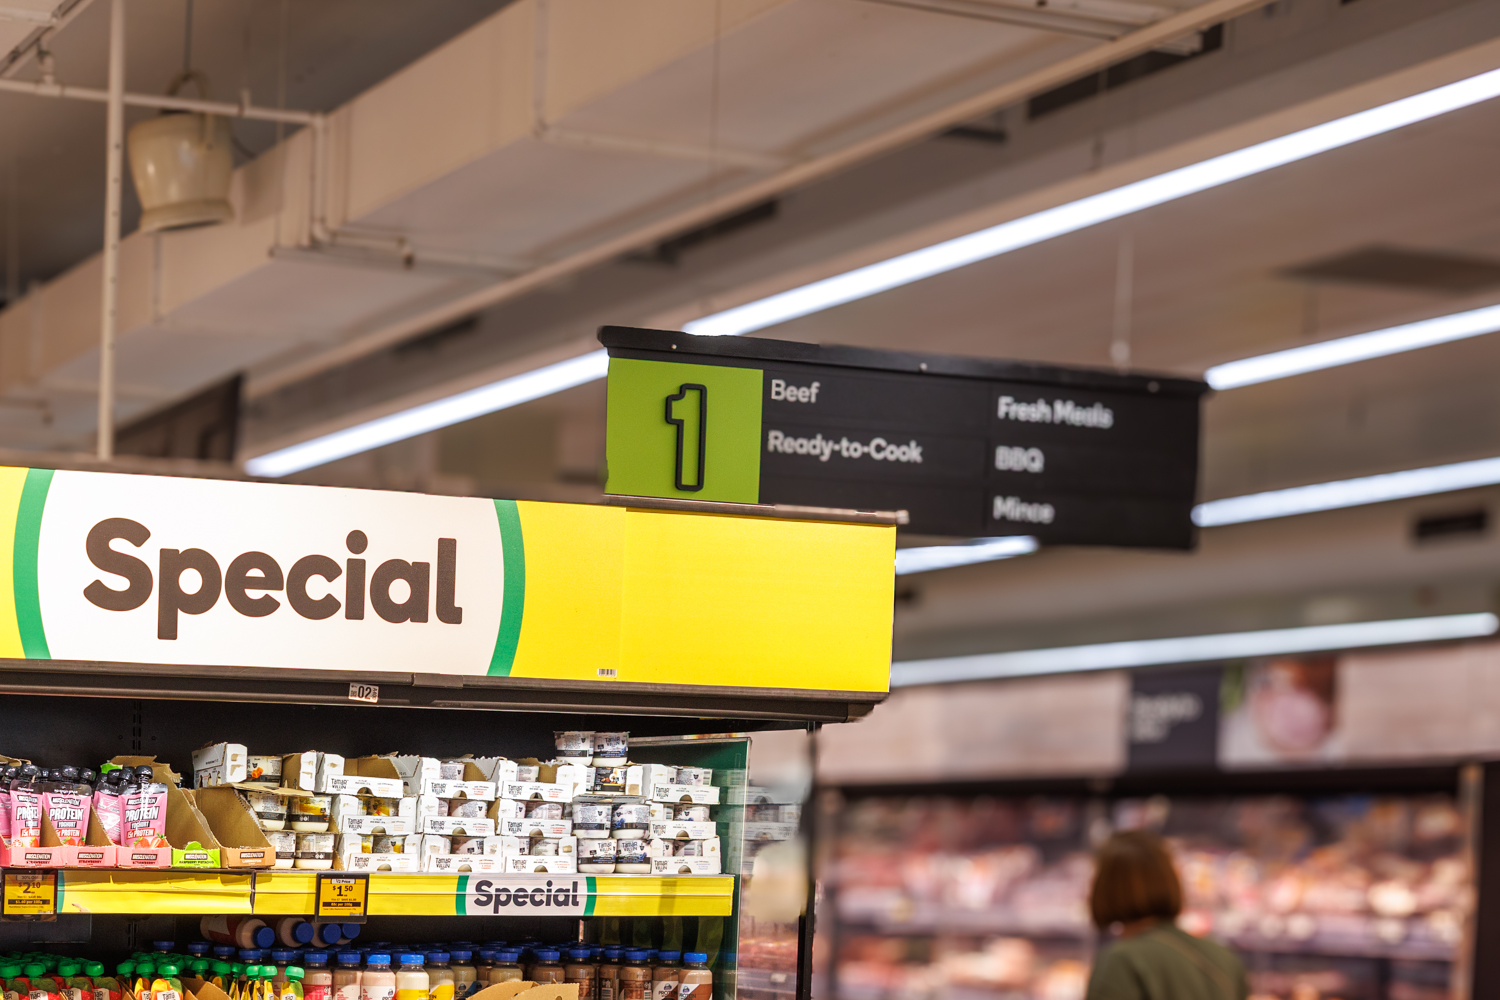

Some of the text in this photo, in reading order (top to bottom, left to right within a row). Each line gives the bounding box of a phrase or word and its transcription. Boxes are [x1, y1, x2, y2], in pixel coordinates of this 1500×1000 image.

[771, 379, 820, 402] Beef
[998, 396, 1114, 429] Fresh Meals
[665, 383, 707, 491] 1
[768, 430, 923, 463] Ready-to-Cook
[995, 446, 1044, 473] BBQ
[83, 517, 463, 640] Special
[358, 686, 371, 699] 02
[50, 808, 84, 820] PROTEIN
[126, 807, 159, 821] PROTEIN
[473, 880, 580, 914] Special
